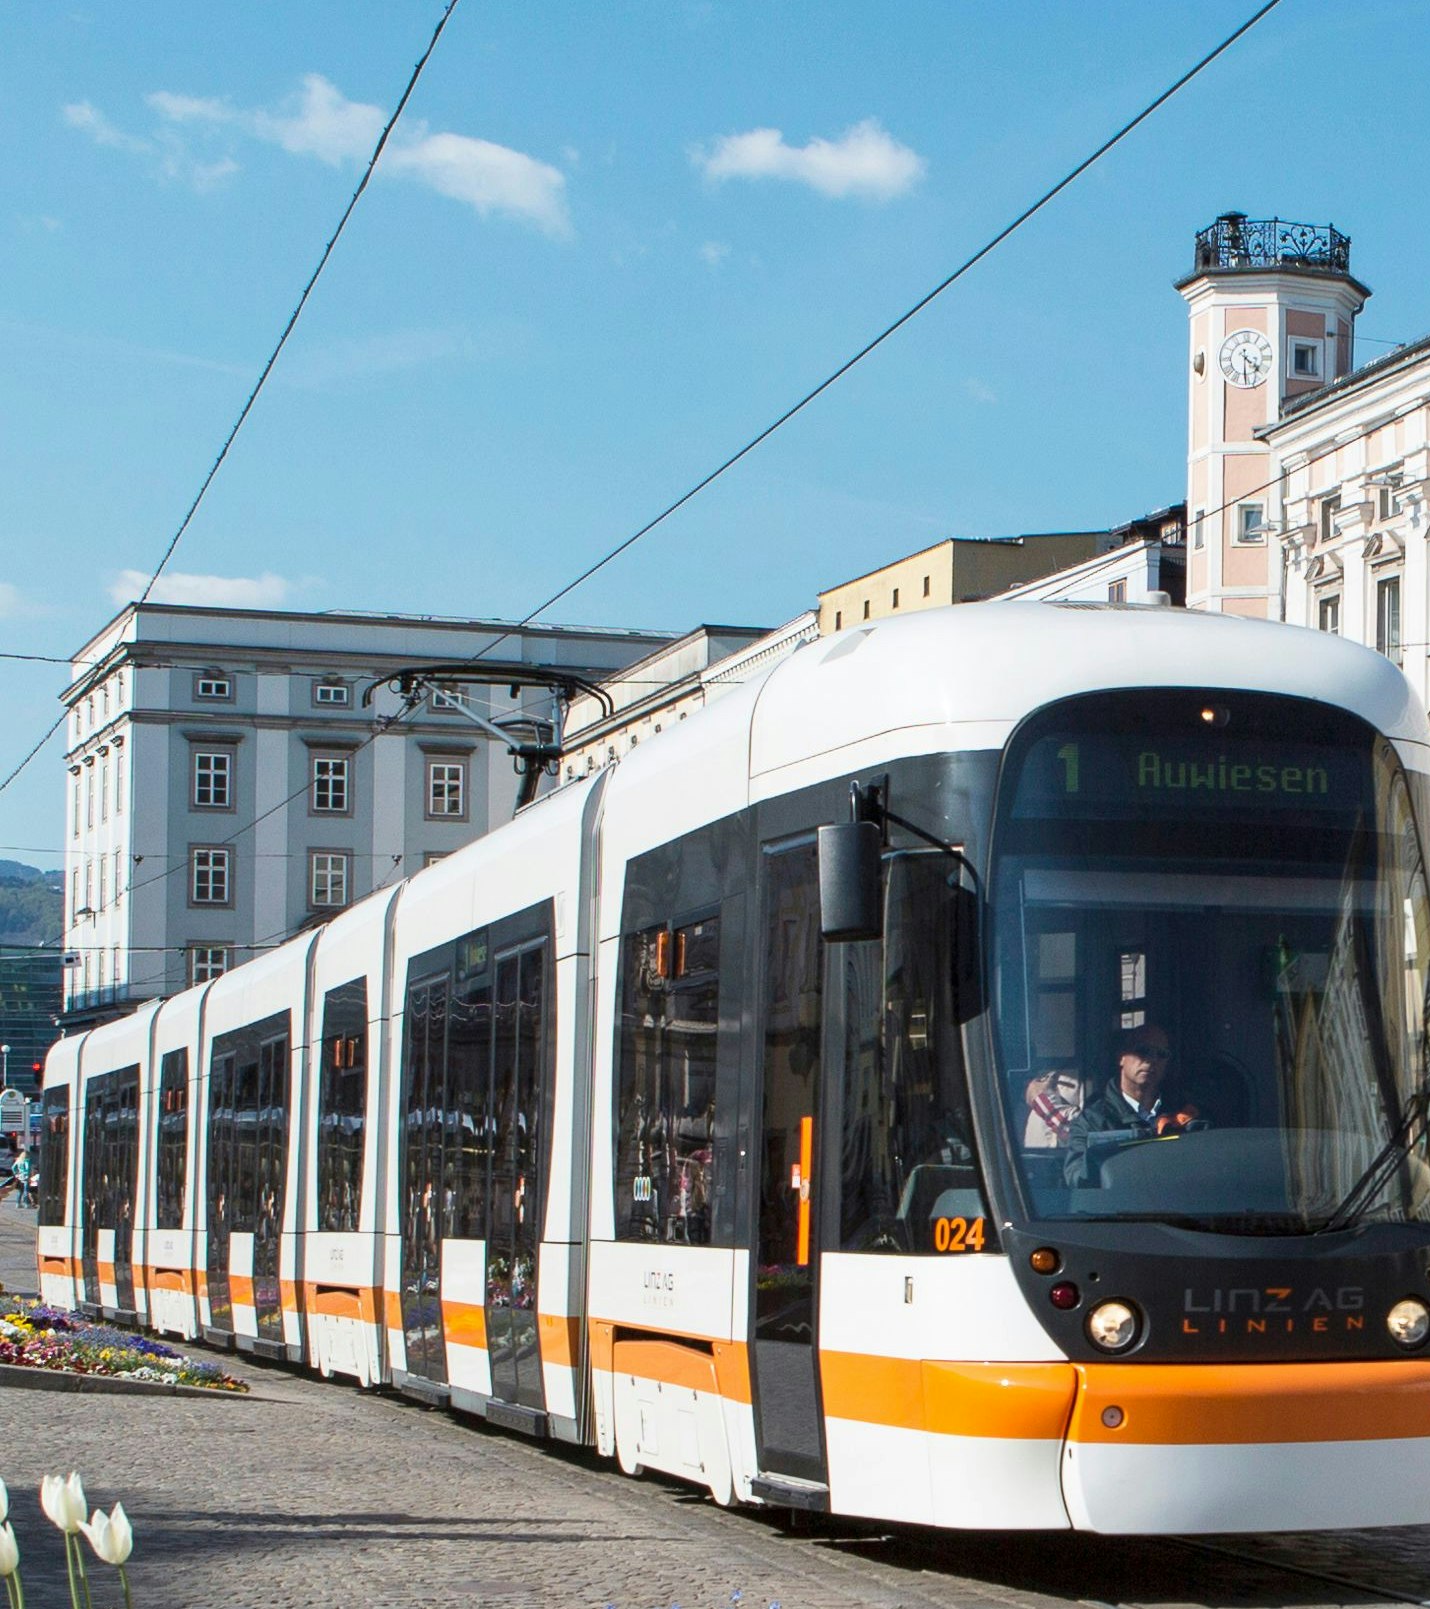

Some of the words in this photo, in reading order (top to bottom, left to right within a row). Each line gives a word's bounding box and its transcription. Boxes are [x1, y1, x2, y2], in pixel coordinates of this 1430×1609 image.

[1057, 743, 1079, 792] 1
[1137, 752, 1328, 793] Auwiesen
[935, 1217, 985, 1251] 024
[1184, 1287, 1292, 1312] LINZ
[1303, 1287, 1364, 1311] AG
[1182, 1315, 1364, 1334] LINIEN
